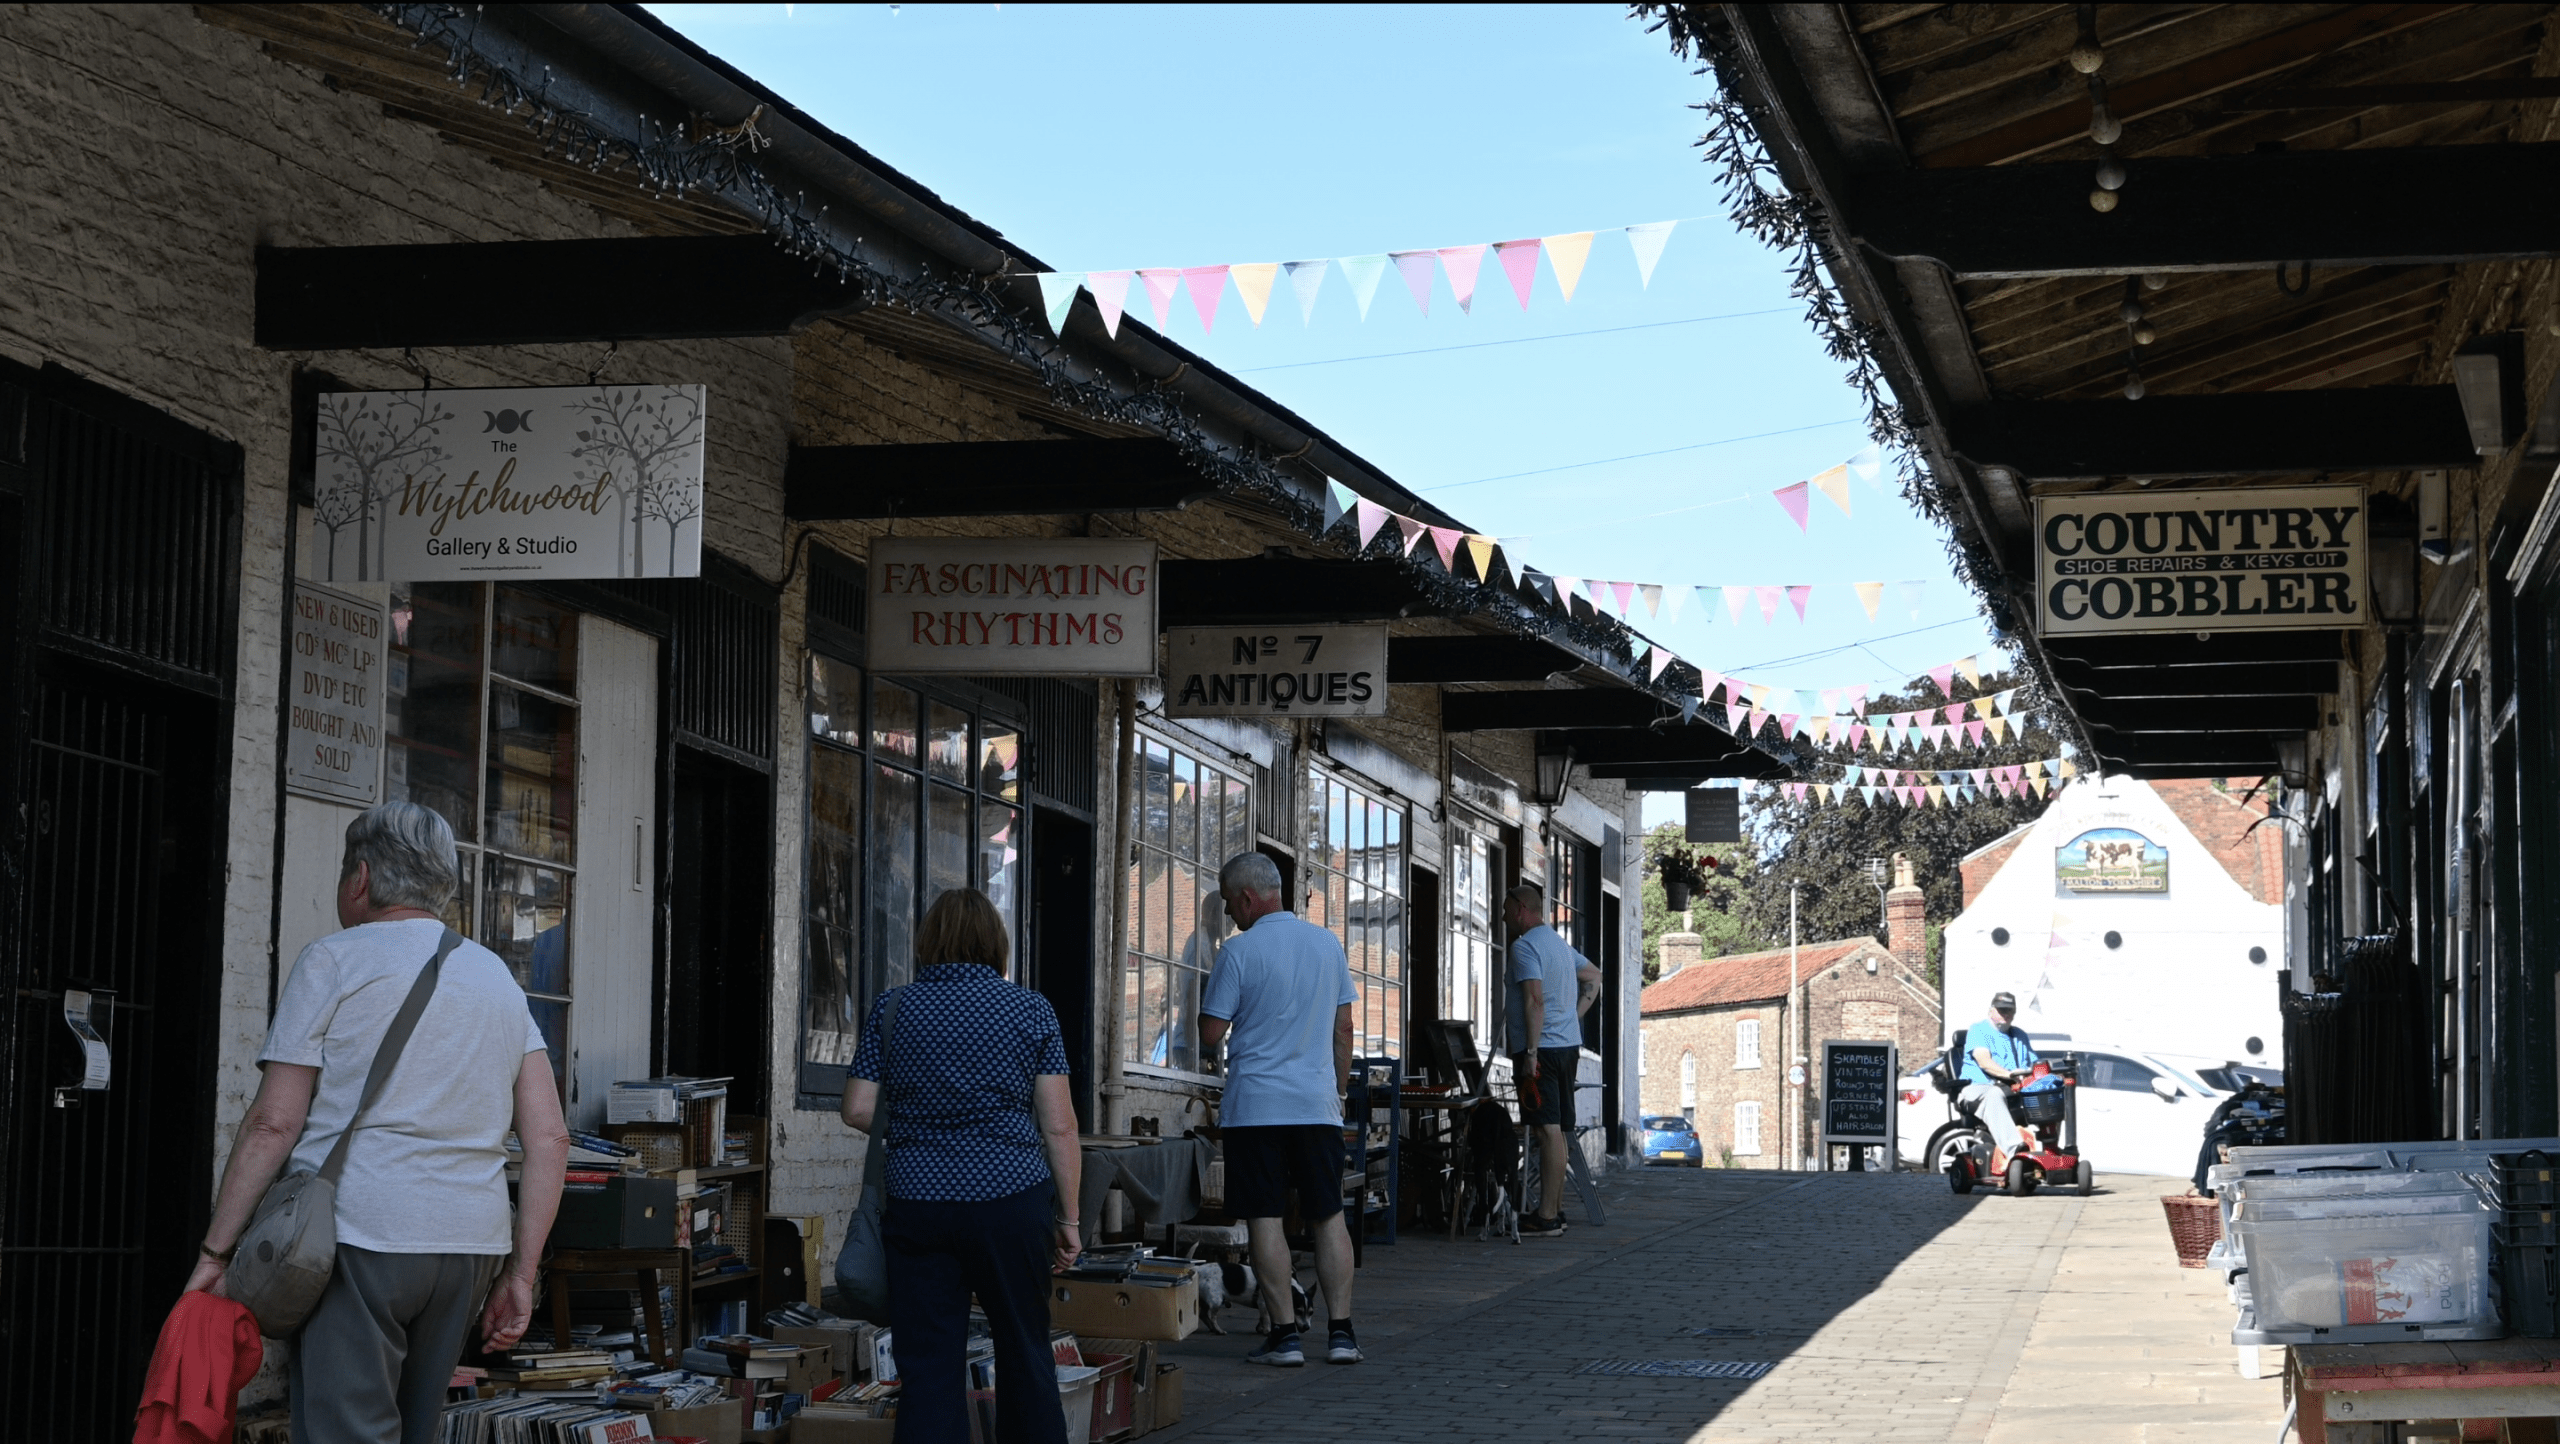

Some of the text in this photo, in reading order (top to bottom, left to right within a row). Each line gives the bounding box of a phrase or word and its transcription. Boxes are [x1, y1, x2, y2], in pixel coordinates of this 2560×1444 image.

[491, 440, 517, 453] The
[398, 457, 613, 537] Wytchwood
[2044, 506, 2359, 556] COUNTRY
[426, 535, 578, 559] Gallery & Studio
[2065, 552, 2338, 575] SHOE REPAIRS & KEYS CUT
[881, 562, 1148, 597] FASCINATING
[2049, 572, 2357, 621] COBBLER
[295, 593, 379, 640] NEW & USED
[912, 610, 1124, 647] RHYTHMS
[1298, 634, 1325, 665] 7
[342, 681, 367, 708] ETC
[1182, 671, 1372, 710] ANTIQUES
[292, 705, 376, 748] BOUGHT AND
[315, 743, 351, 773] SOLD
[2066, 878, 2102, 887] MALTON
[1835, 1078, 1884, 1090] ROUND THE
[1835, 1091, 1878, 1100] CORNER
[603, 1419, 639, 1443] JOHNNY
